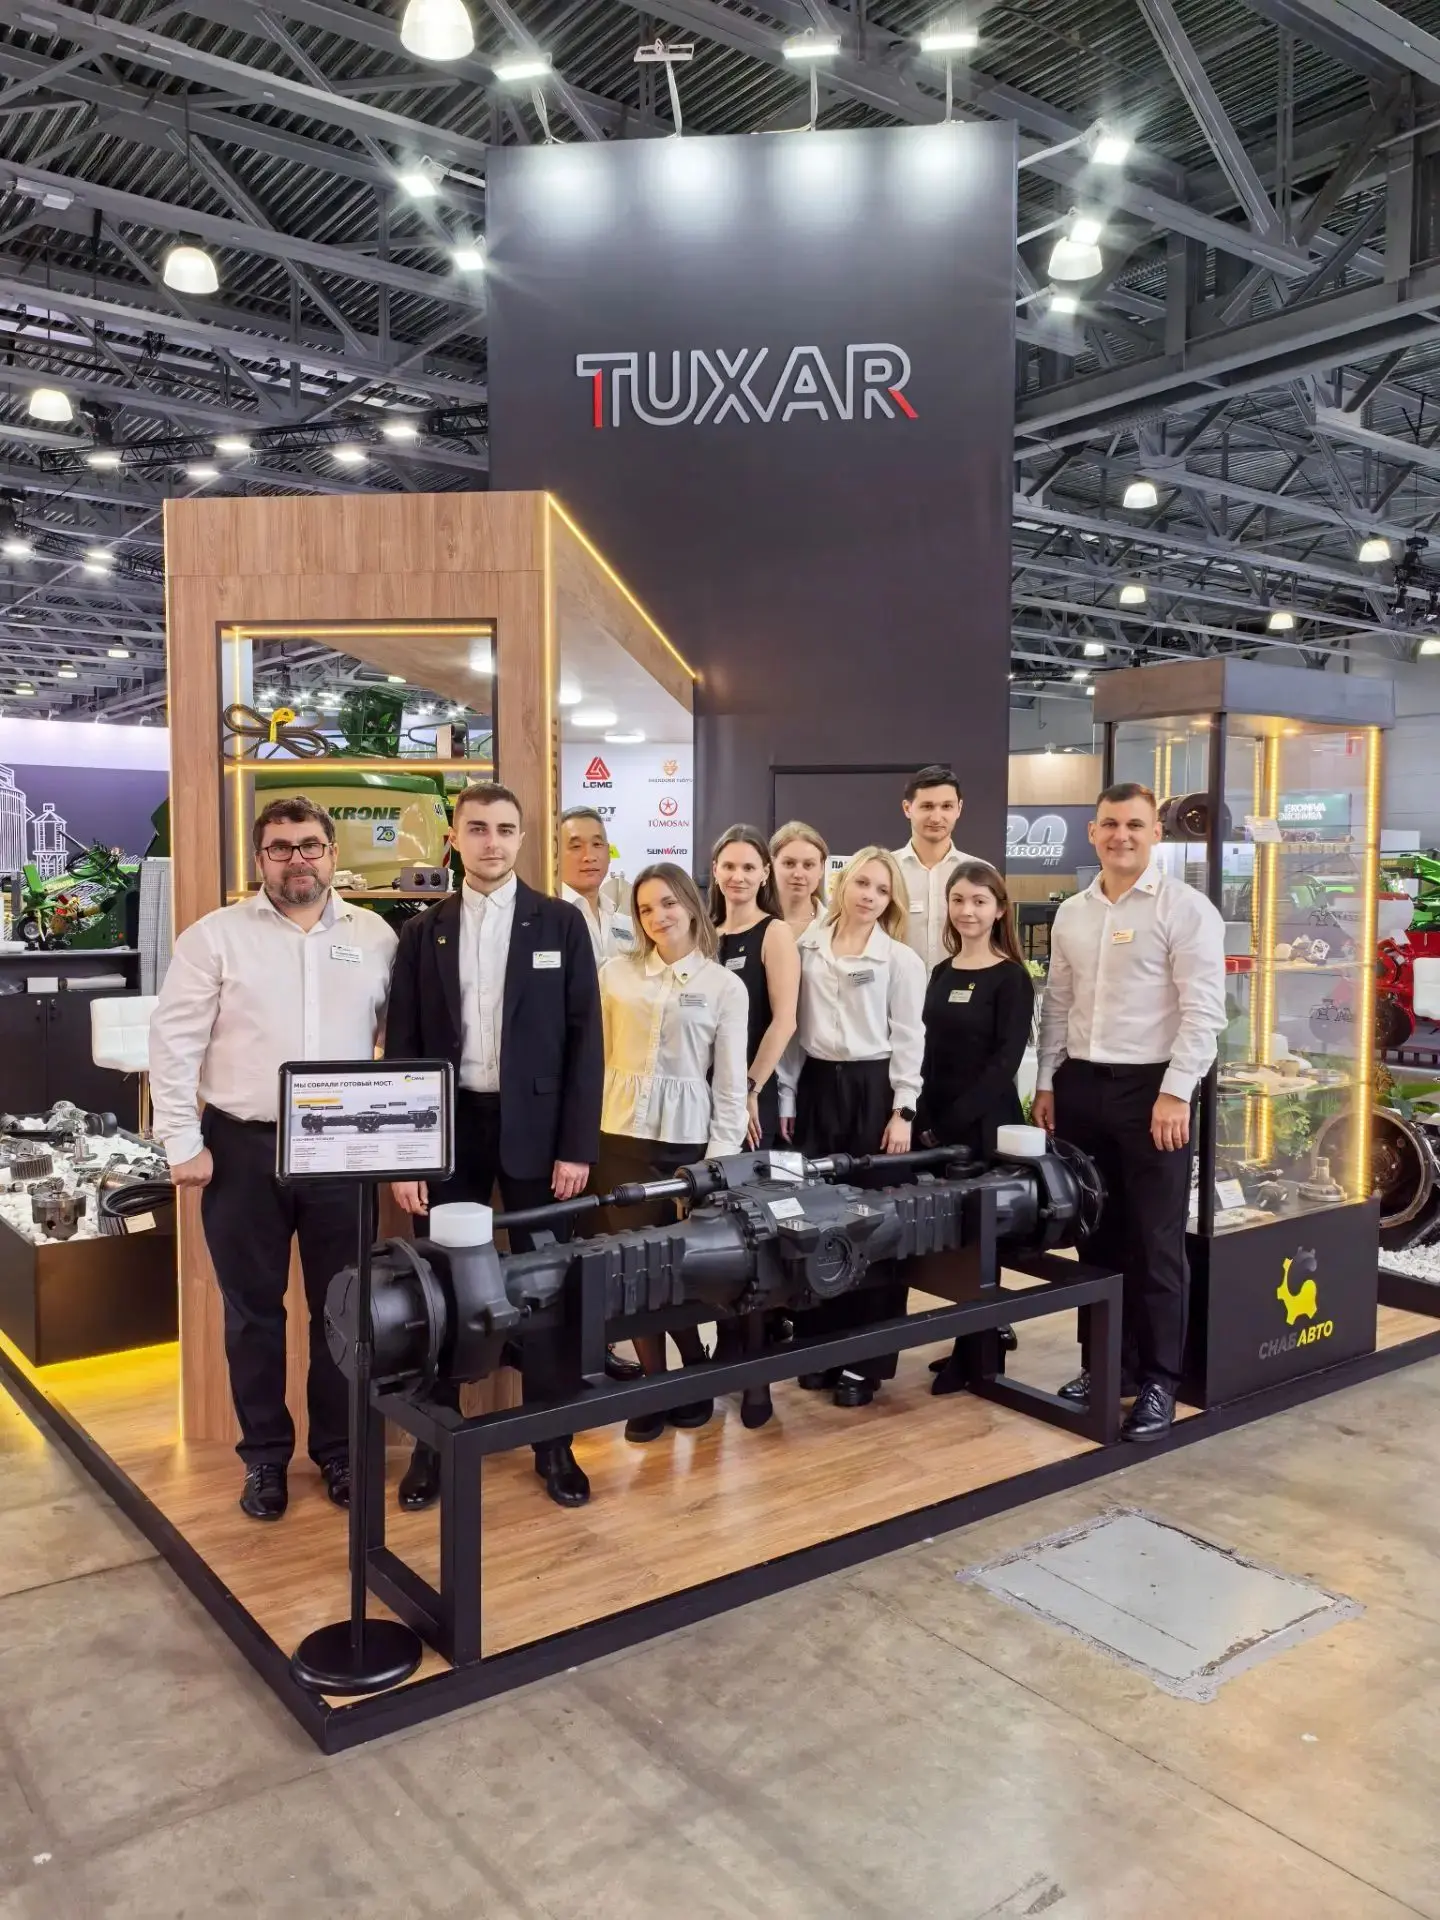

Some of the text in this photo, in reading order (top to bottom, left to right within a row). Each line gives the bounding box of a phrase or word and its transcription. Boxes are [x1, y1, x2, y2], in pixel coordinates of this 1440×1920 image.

[576, 343, 919, 428] TUXAR
[328, 806, 401, 821] KRONE
[1006, 844, 1065, 857] KRONE
[308, 1081, 340, 1089] СОБРАЛИ
